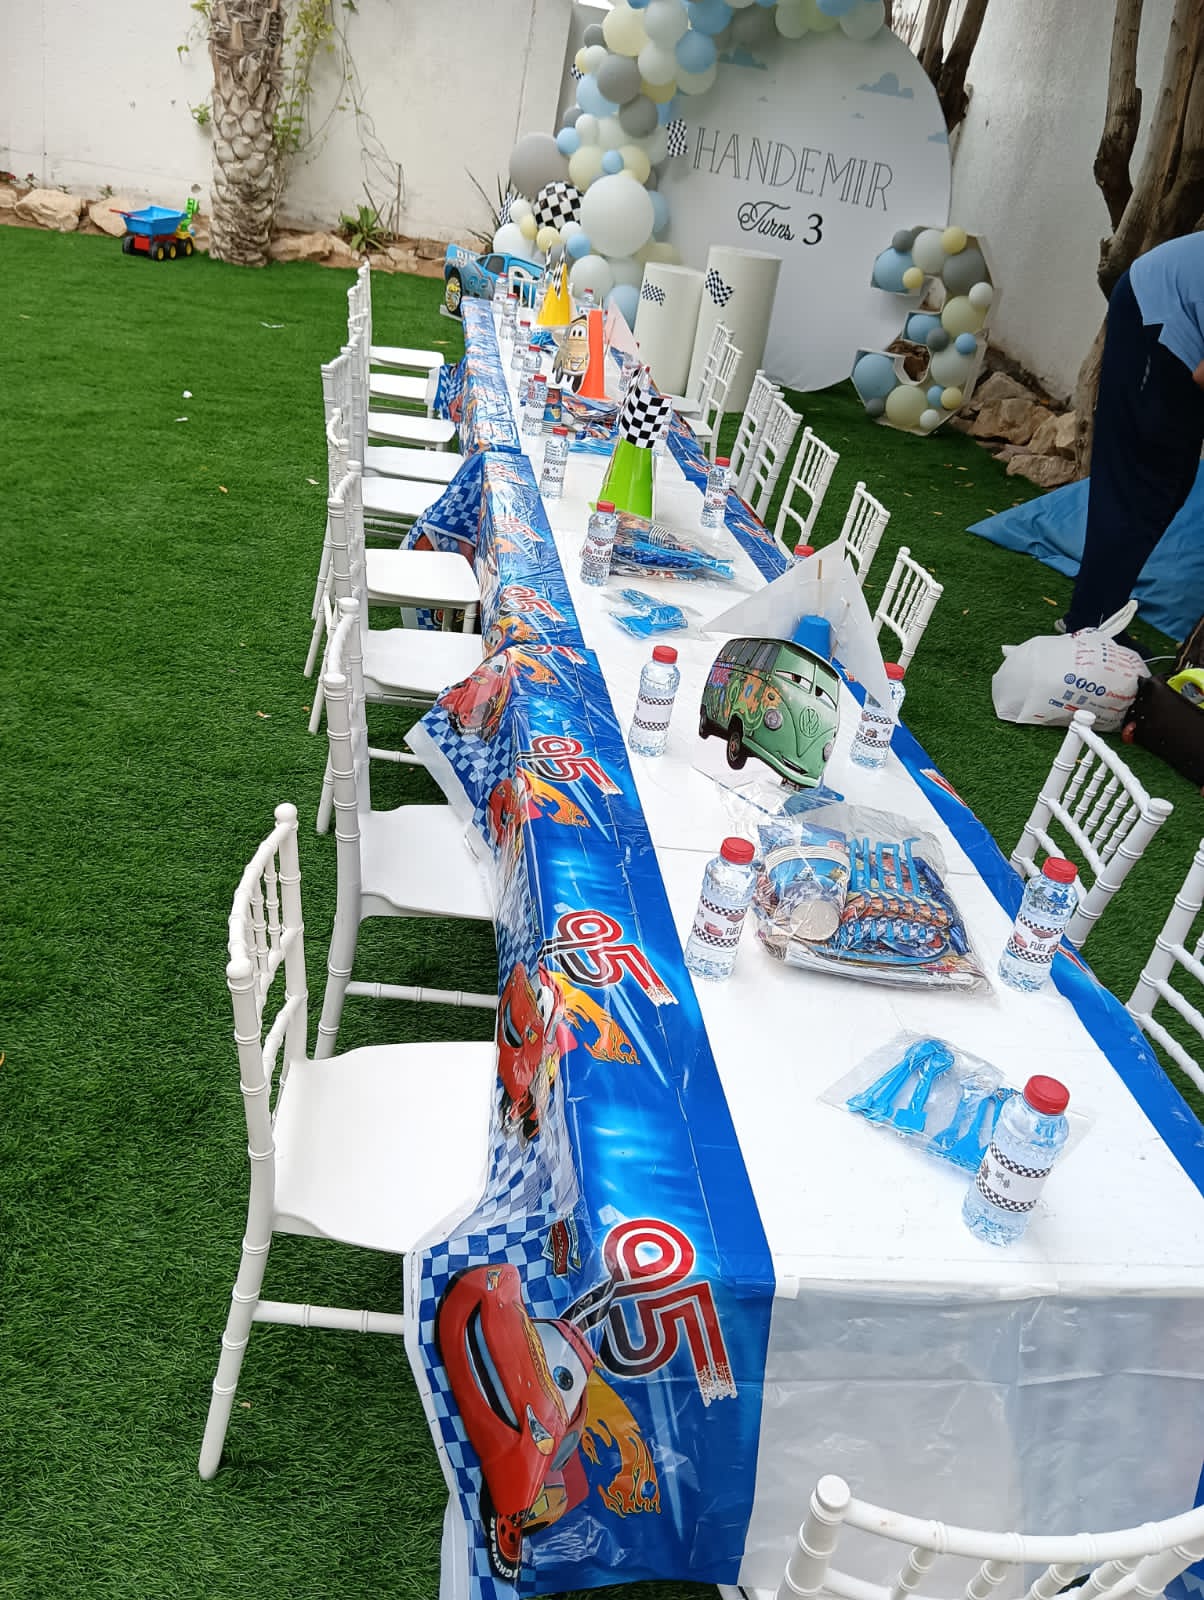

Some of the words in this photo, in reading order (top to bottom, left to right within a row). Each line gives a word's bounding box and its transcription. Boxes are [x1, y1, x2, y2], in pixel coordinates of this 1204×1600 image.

[693, 127, 893, 211] HANDEMIR
[737, 200, 795, 241] Turns
[802, 213, 824, 245] 3
[515, 734, 624, 795] 95
[537, 908, 680, 1007] 95
[1028, 940, 1047, 953] FUEL
[560, 1216, 738, 1408] 95
[489, 1516, 522, 1579] IGHTYEAR
